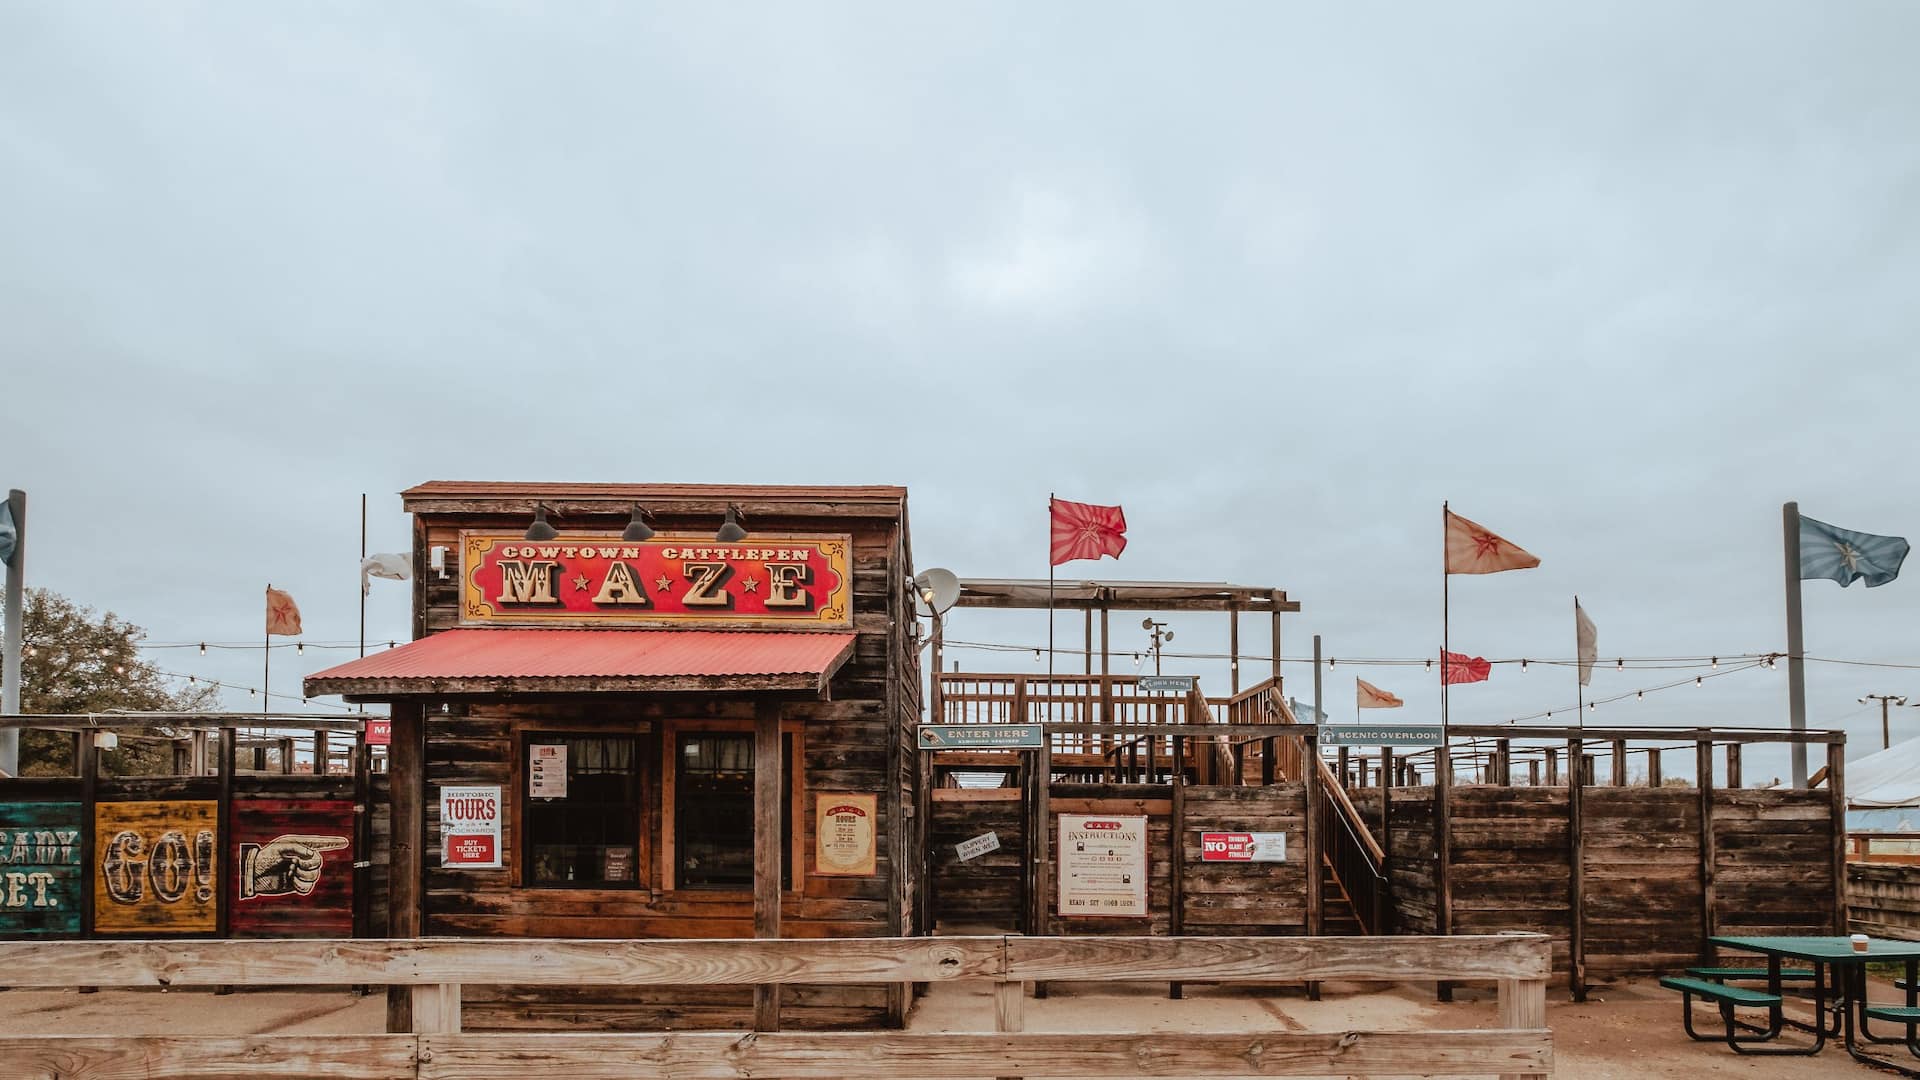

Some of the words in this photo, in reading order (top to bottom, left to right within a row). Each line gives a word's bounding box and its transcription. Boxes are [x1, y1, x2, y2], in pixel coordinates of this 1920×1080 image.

[502, 546, 640, 559] COWTOWN
[661, 547, 810, 561] CATTLEPEN
[947, 730, 991, 738] ENTER
[995, 729, 1030, 738] HERE
[446, 799, 496, 820] TOURS
[1068, 832, 1137, 841] INSTRUCTIONS
[1204, 842, 1227, 852] NO
[103, 830, 214, 903] GO!
